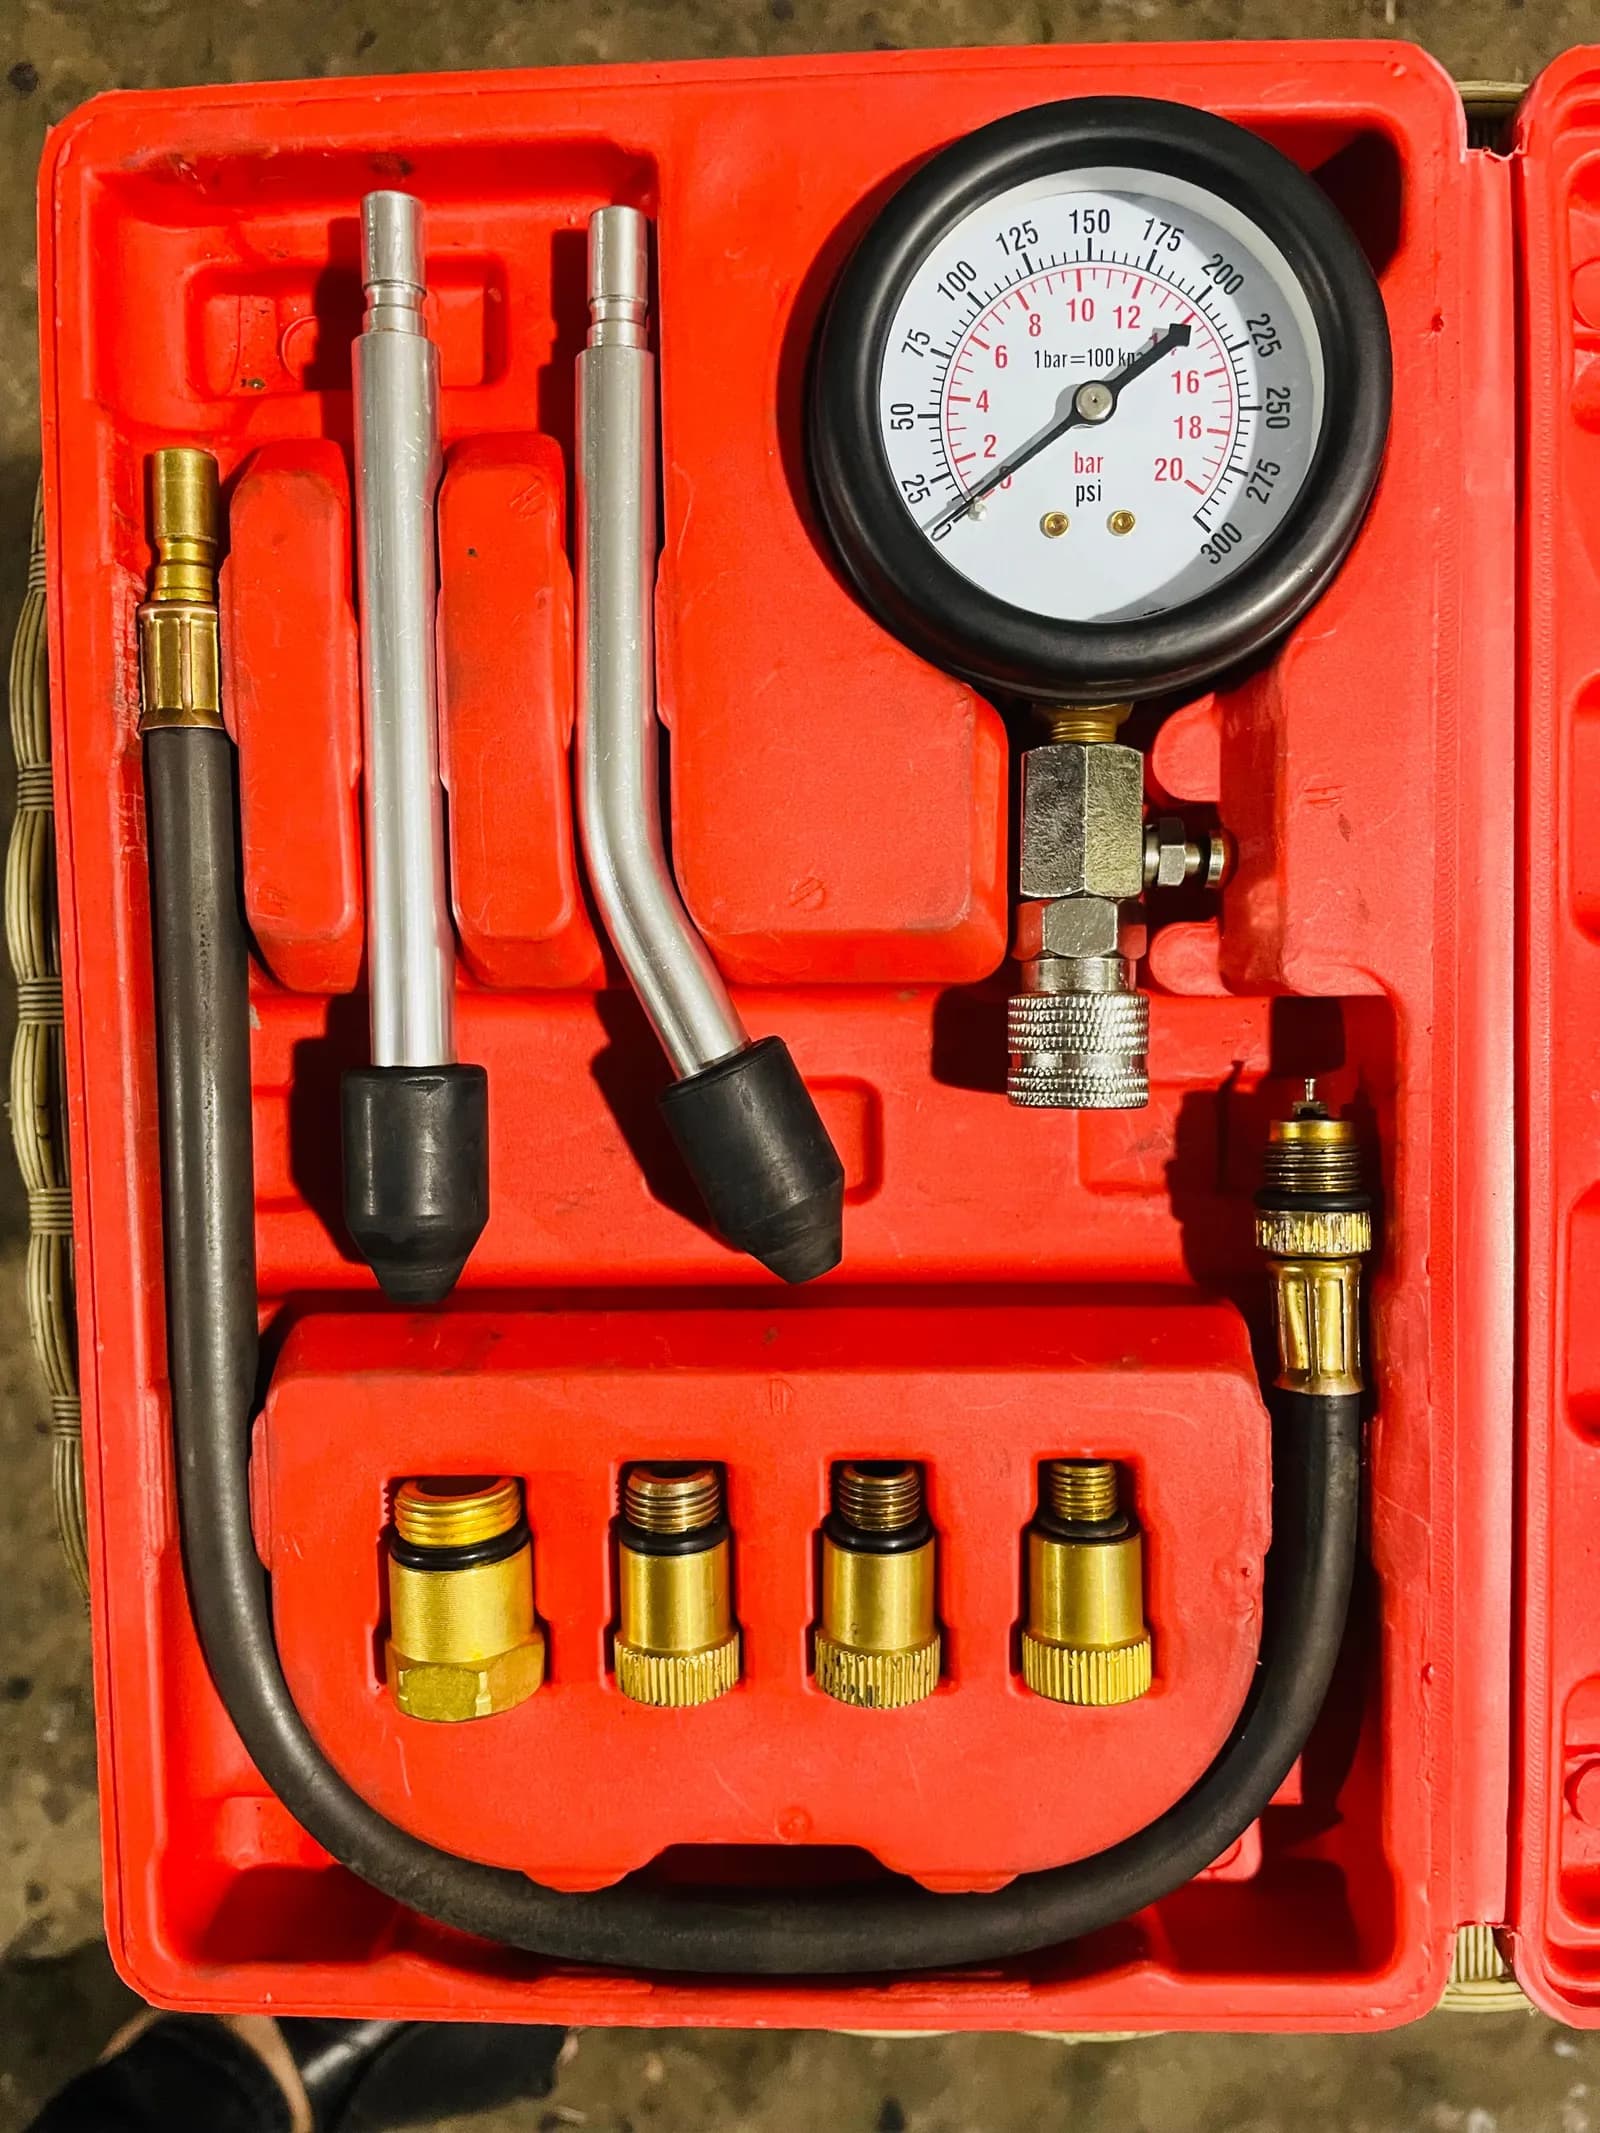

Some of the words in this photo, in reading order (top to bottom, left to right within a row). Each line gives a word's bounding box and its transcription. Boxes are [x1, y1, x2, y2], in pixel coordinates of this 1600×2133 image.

[1068, 208, 1111, 234] 150
[1143, 217, 1185, 252] 175
[995, 219, 1039, 256] 125
[936, 260, 977, 301] 100
[1201, 253, 1244, 295] 200
[1066, 298, 1094, 322] 10
[1112, 305, 1140, 329] 12
[1028, 313, 1042, 337] 8
[1246, 313, 1282, 358] 225
[901, 328, 930, 357] 75
[995, 345, 1008, 369] 6
[1171, 370, 1200, 394] 16
[976, 389, 989, 413] 4
[1265, 386, 1291, 429] 250
[890, 403, 914, 431] 50
[1174, 415, 1202, 439] 18
[983, 434, 996, 458] 2
[1074, 451, 1104, 474] bar
[1154, 457, 1183, 482] 20
[901, 474, 931, 504] 25
[1075, 479, 1102, 507] psi
[1246, 458, 1281, 504] 275
[1200, 522, 1243, 565] 300
